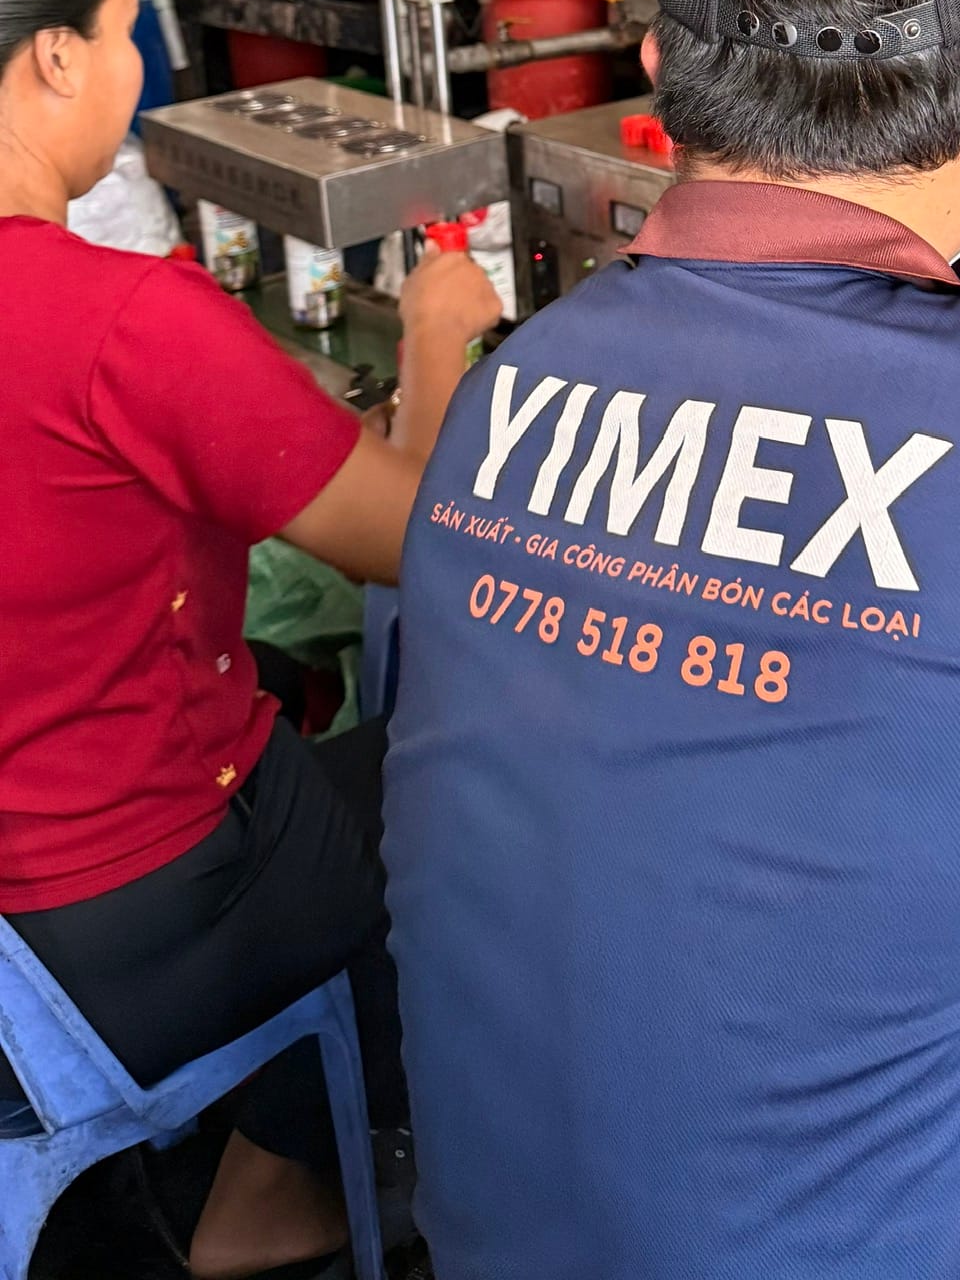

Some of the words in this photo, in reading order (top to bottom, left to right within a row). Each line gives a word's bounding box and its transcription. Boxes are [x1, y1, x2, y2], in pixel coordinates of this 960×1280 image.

[473, 364, 954, 592] YIMEX
[430, 501, 466, 532] SẢN
[464, 515, 515, 545] XUẤT
[526, 533, 559, 560] GIA
[563, 543, 626, 578] CÔNG
[627, 561, 699, 596] PHÂN
[701, 576, 765, 610] BÓN
[771, 590, 833, 624] CÁC
[842, 602, 921, 641] LOẠI
[469, 574, 565, 644] 0778
[576, 607, 664, 673] 518
[680, 635, 791, 703] 818
